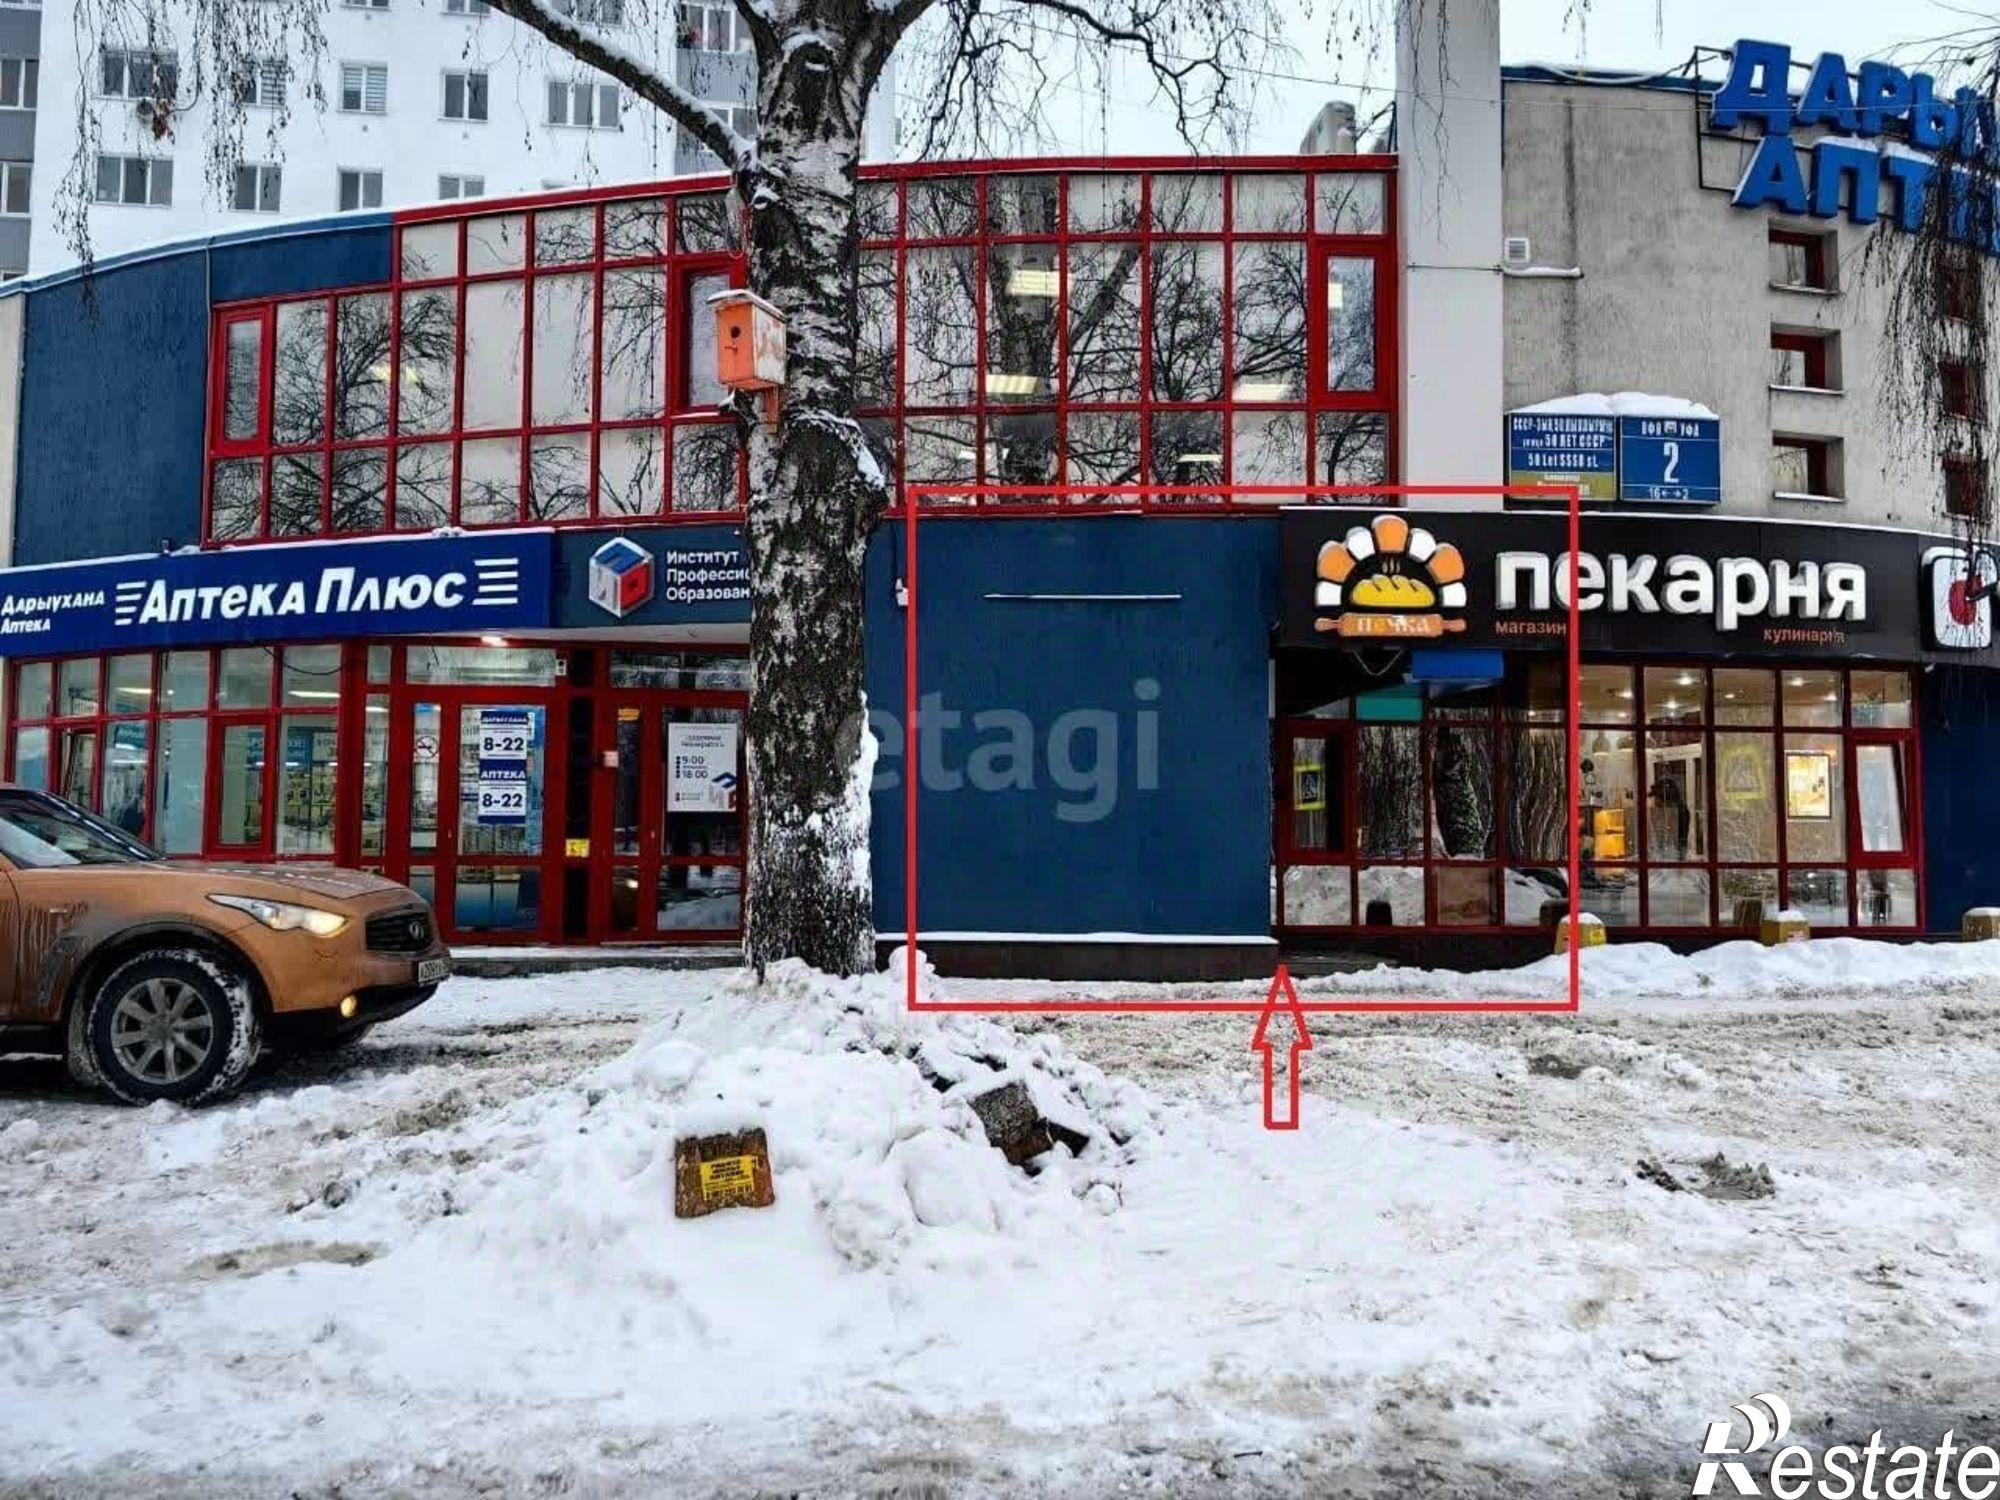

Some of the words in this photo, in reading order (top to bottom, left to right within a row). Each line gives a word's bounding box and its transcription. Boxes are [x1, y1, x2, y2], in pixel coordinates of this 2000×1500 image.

[1545, 434, 1557, 447] 50
[1579, 434, 1605, 447] СССР
[1528, 453, 1541, 467] 50
[1663, 442, 1680, 483] 2
[666, 550, 739, 567] Институт
[314, 566, 467, 613] Плюс
[1495, 550, 1867, 632] пекарня
[1495, 622, 1567, 637] магазин
[484, 737, 524, 751] 8-22
[481, 770, 526, 779] АПТЕКА
[482, 794, 523, 807] 8-22
